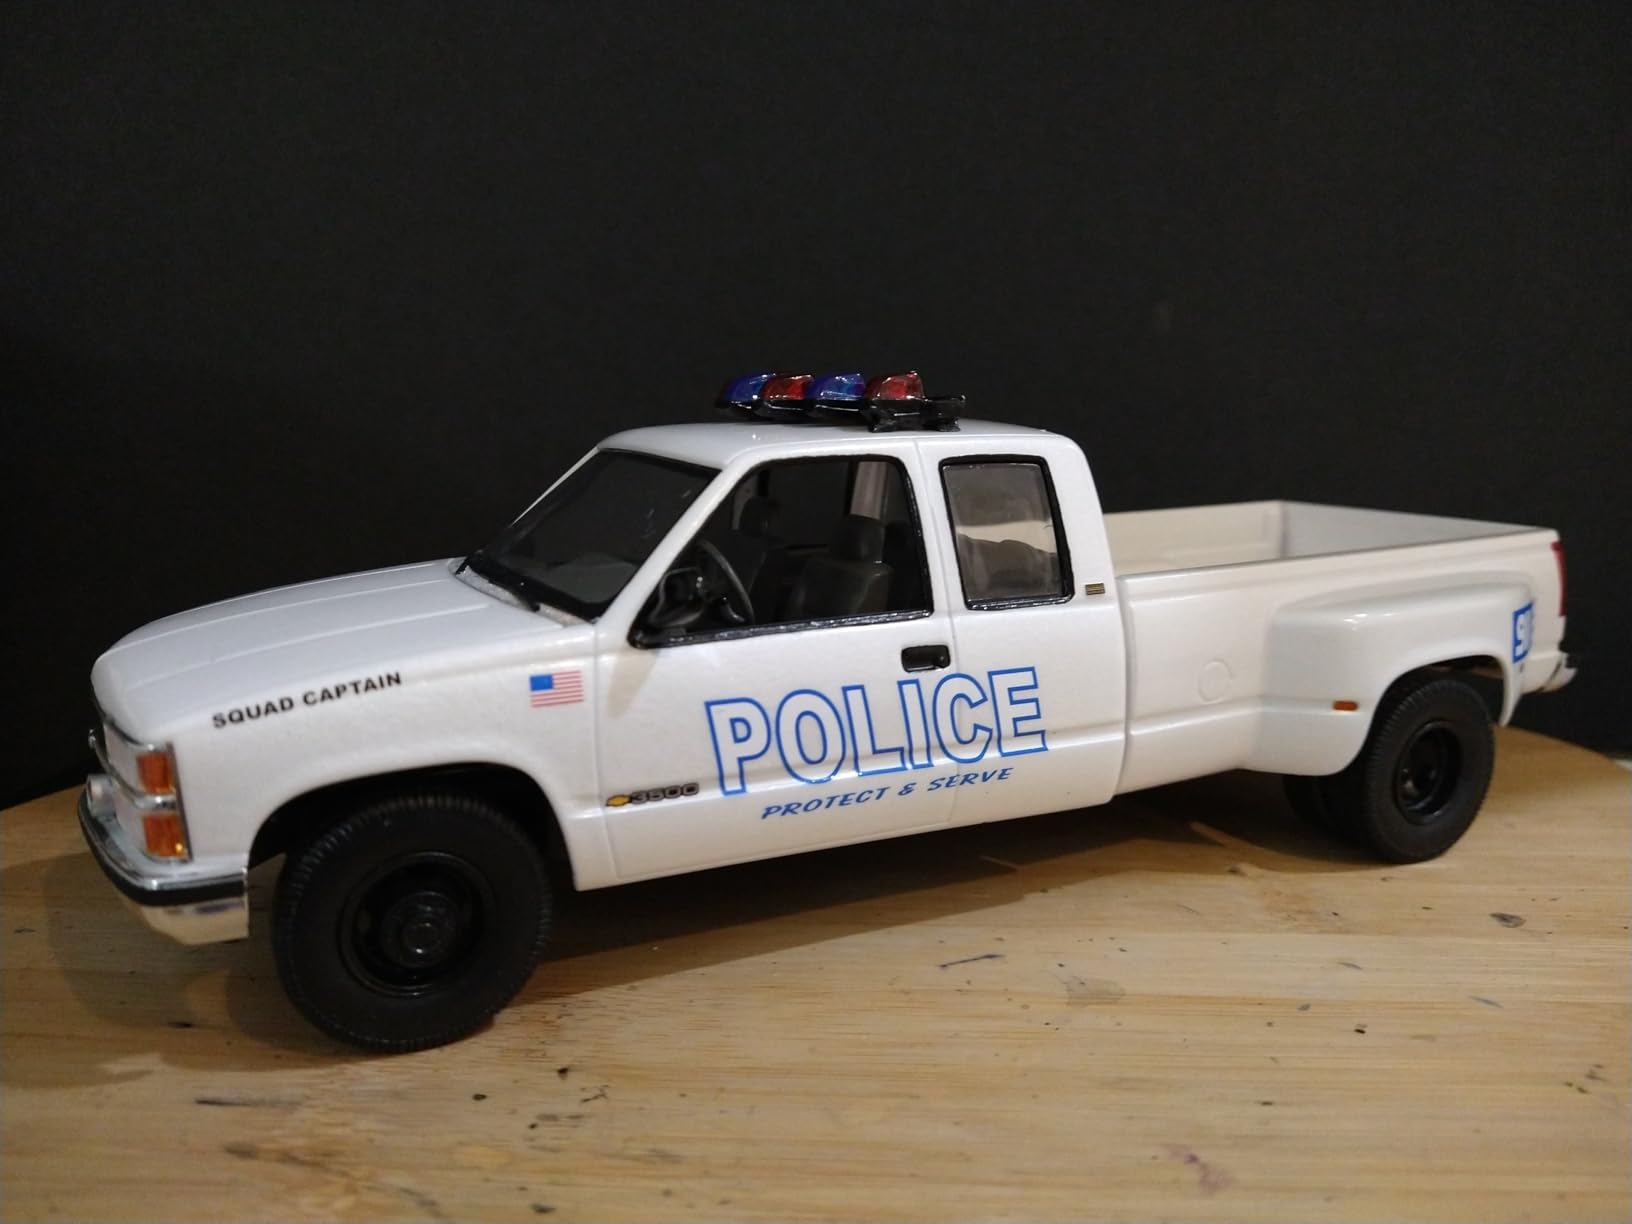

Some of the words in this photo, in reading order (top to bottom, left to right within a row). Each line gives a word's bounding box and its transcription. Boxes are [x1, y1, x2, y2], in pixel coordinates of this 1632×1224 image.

[212, 697, 294, 729] SQUAD
[302, 671, 402, 706] CAPTAIN
[704, 667, 1047, 796] POLICE
[631, 782, 699, 805] 3500
[760, 787, 890, 820] PROTECT
[898, 782, 919, 797] &
[926, 767, 1014, 792] SERVE
